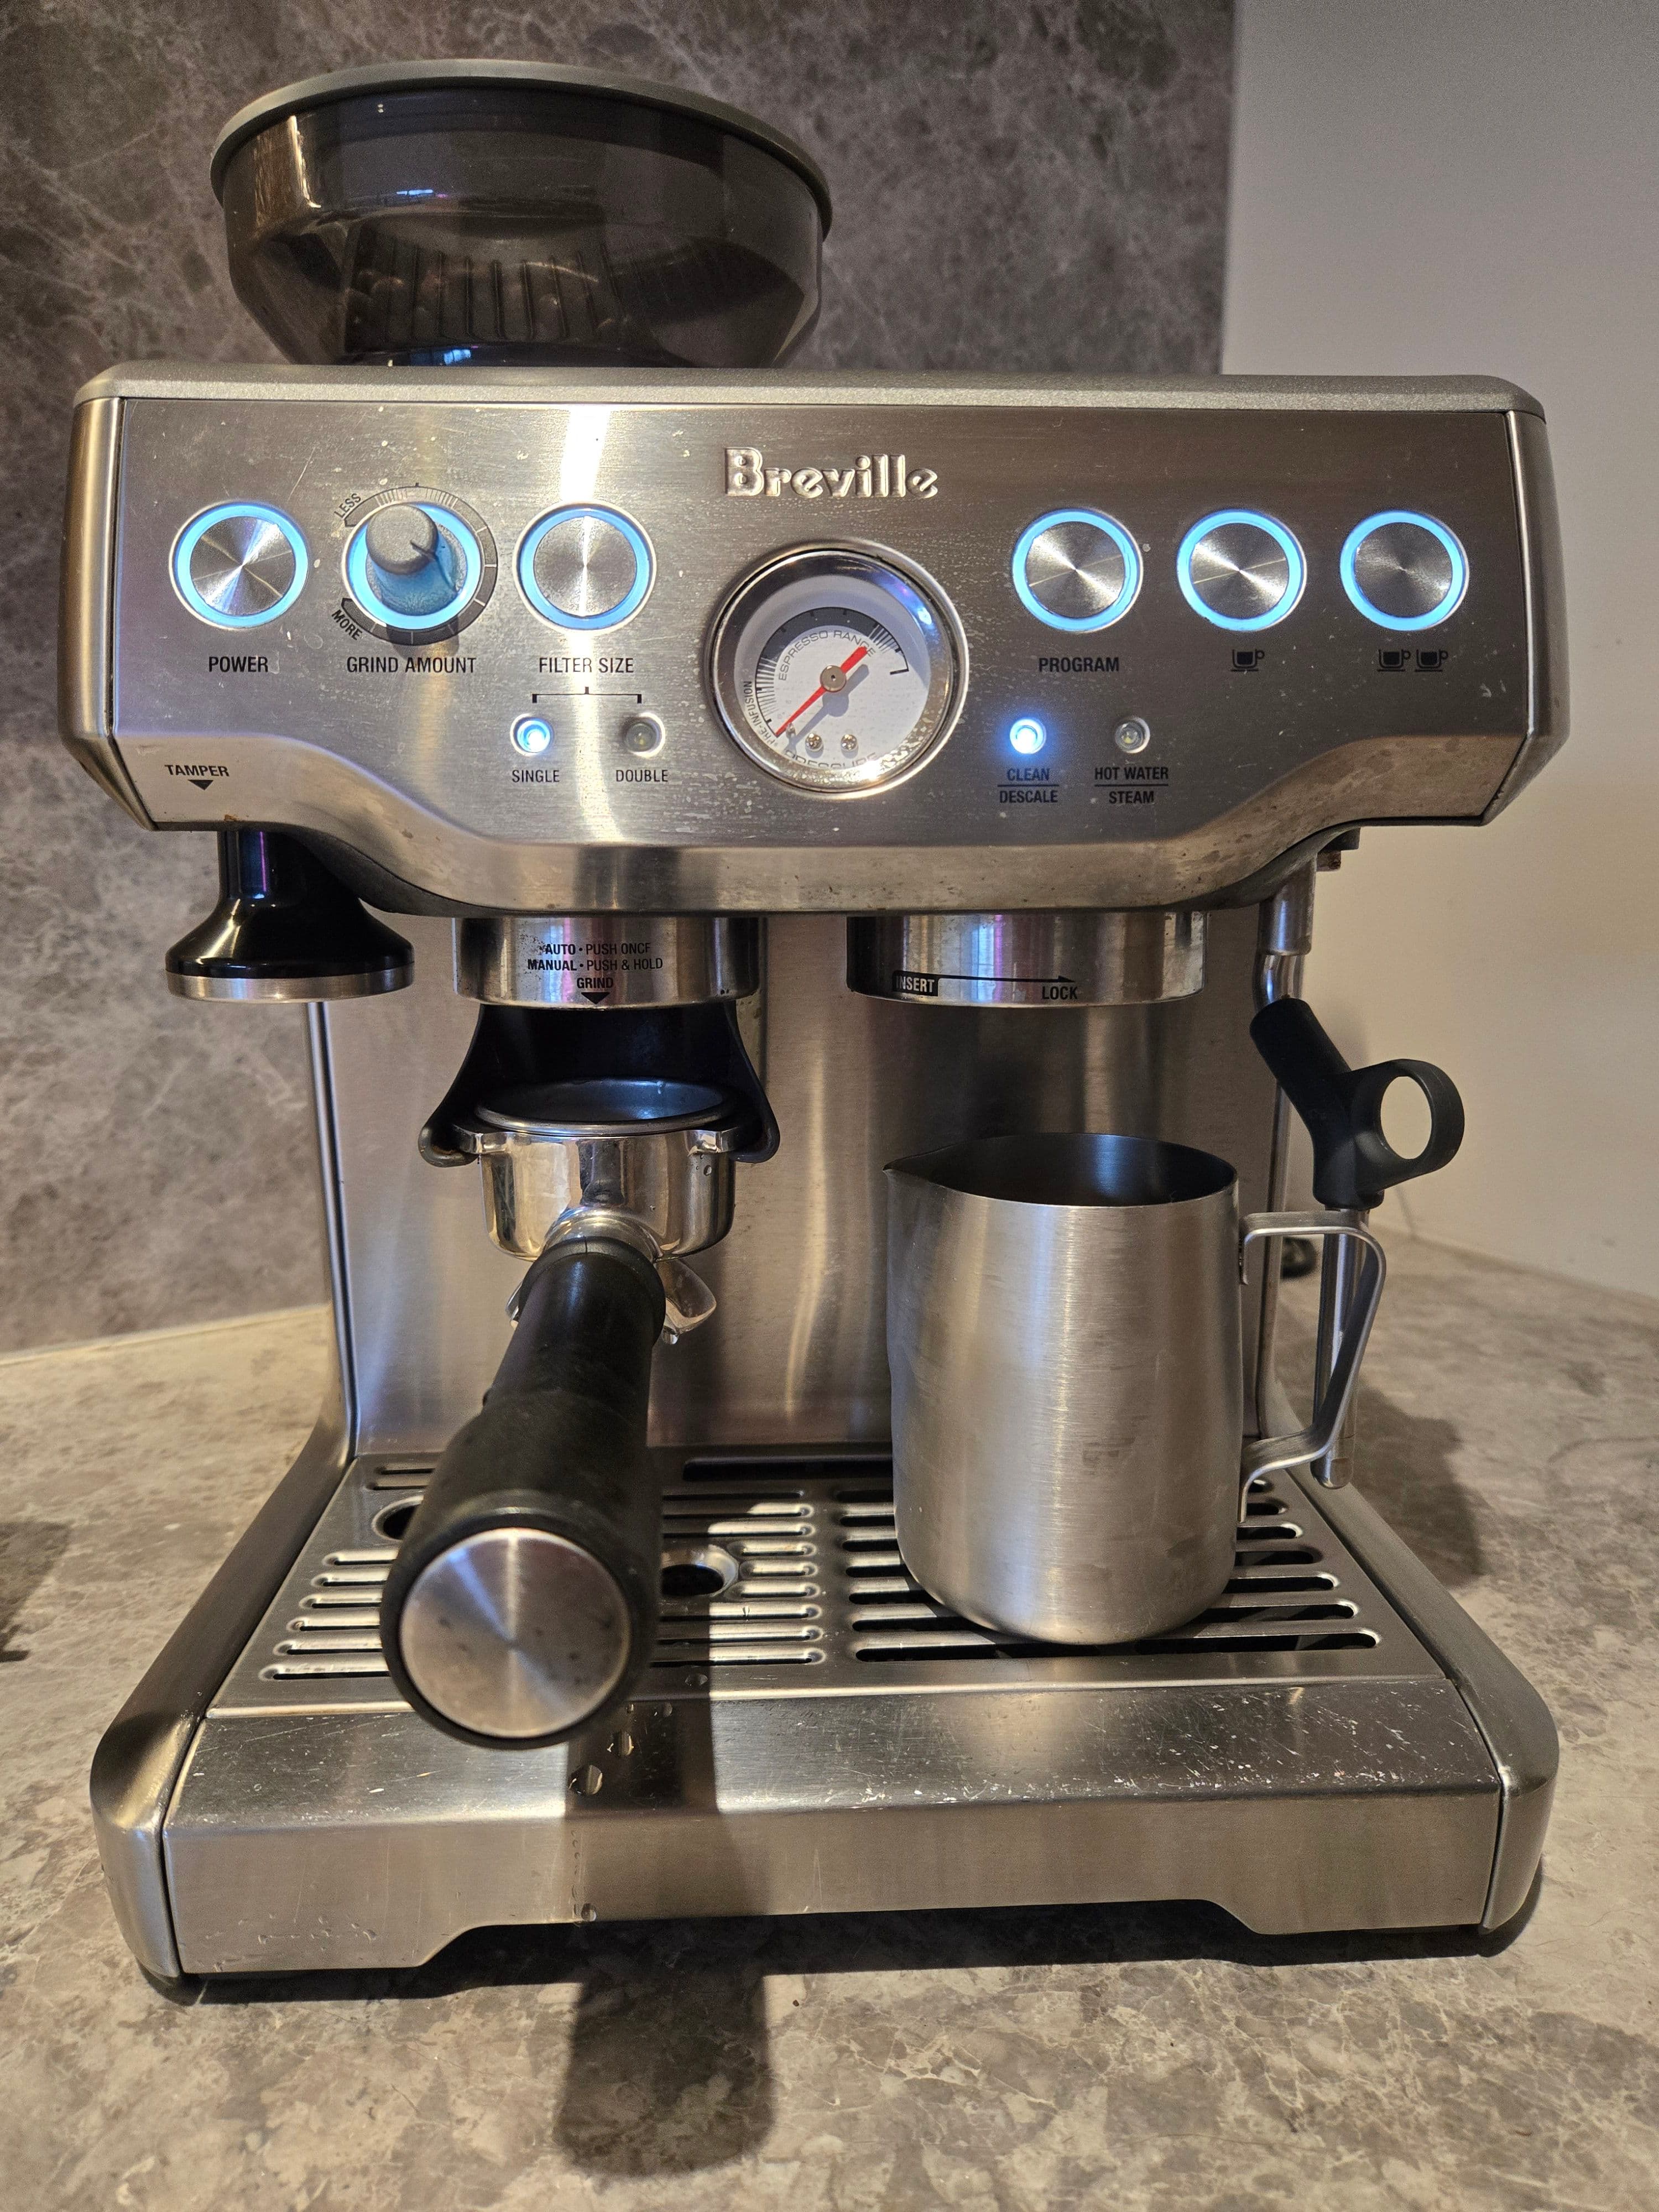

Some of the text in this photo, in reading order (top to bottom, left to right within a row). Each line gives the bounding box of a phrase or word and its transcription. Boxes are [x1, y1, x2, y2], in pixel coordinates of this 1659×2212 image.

[725, 446, 938, 498] Breville
[334, 493, 362, 519] LESS
[331, 609, 363, 640] MORE
[778, 630, 828, 681] ESPRESSO
[208, 656, 268, 673] POWER
[347, 656, 476, 674] GRIND AMOUNT
[539, 658, 634, 673] FILTER SIZE
[1039, 657, 1119, 672] PROGRAM
[165, 765, 229, 777] TAMPER
[512, 770, 560, 782] SINGLE
[615, 769, 669, 782] DOUBLE
[1007, 768, 1050, 781] CLEAN
[1094, 766, 1169, 780] HOT WATER
[999, 790, 1058, 803] DESCALE
[1109, 791, 1154, 804] STEAM
[545, 944, 576, 955] AUTO
[586, 943, 617, 955] PUSH
[528, 958, 663, 971] MANUAL PUSH & HOLD
[577, 977, 613, 989] GRIND
[896, 975, 935, 993] INSERT
[1042, 986, 1078, 1000] LOCK
